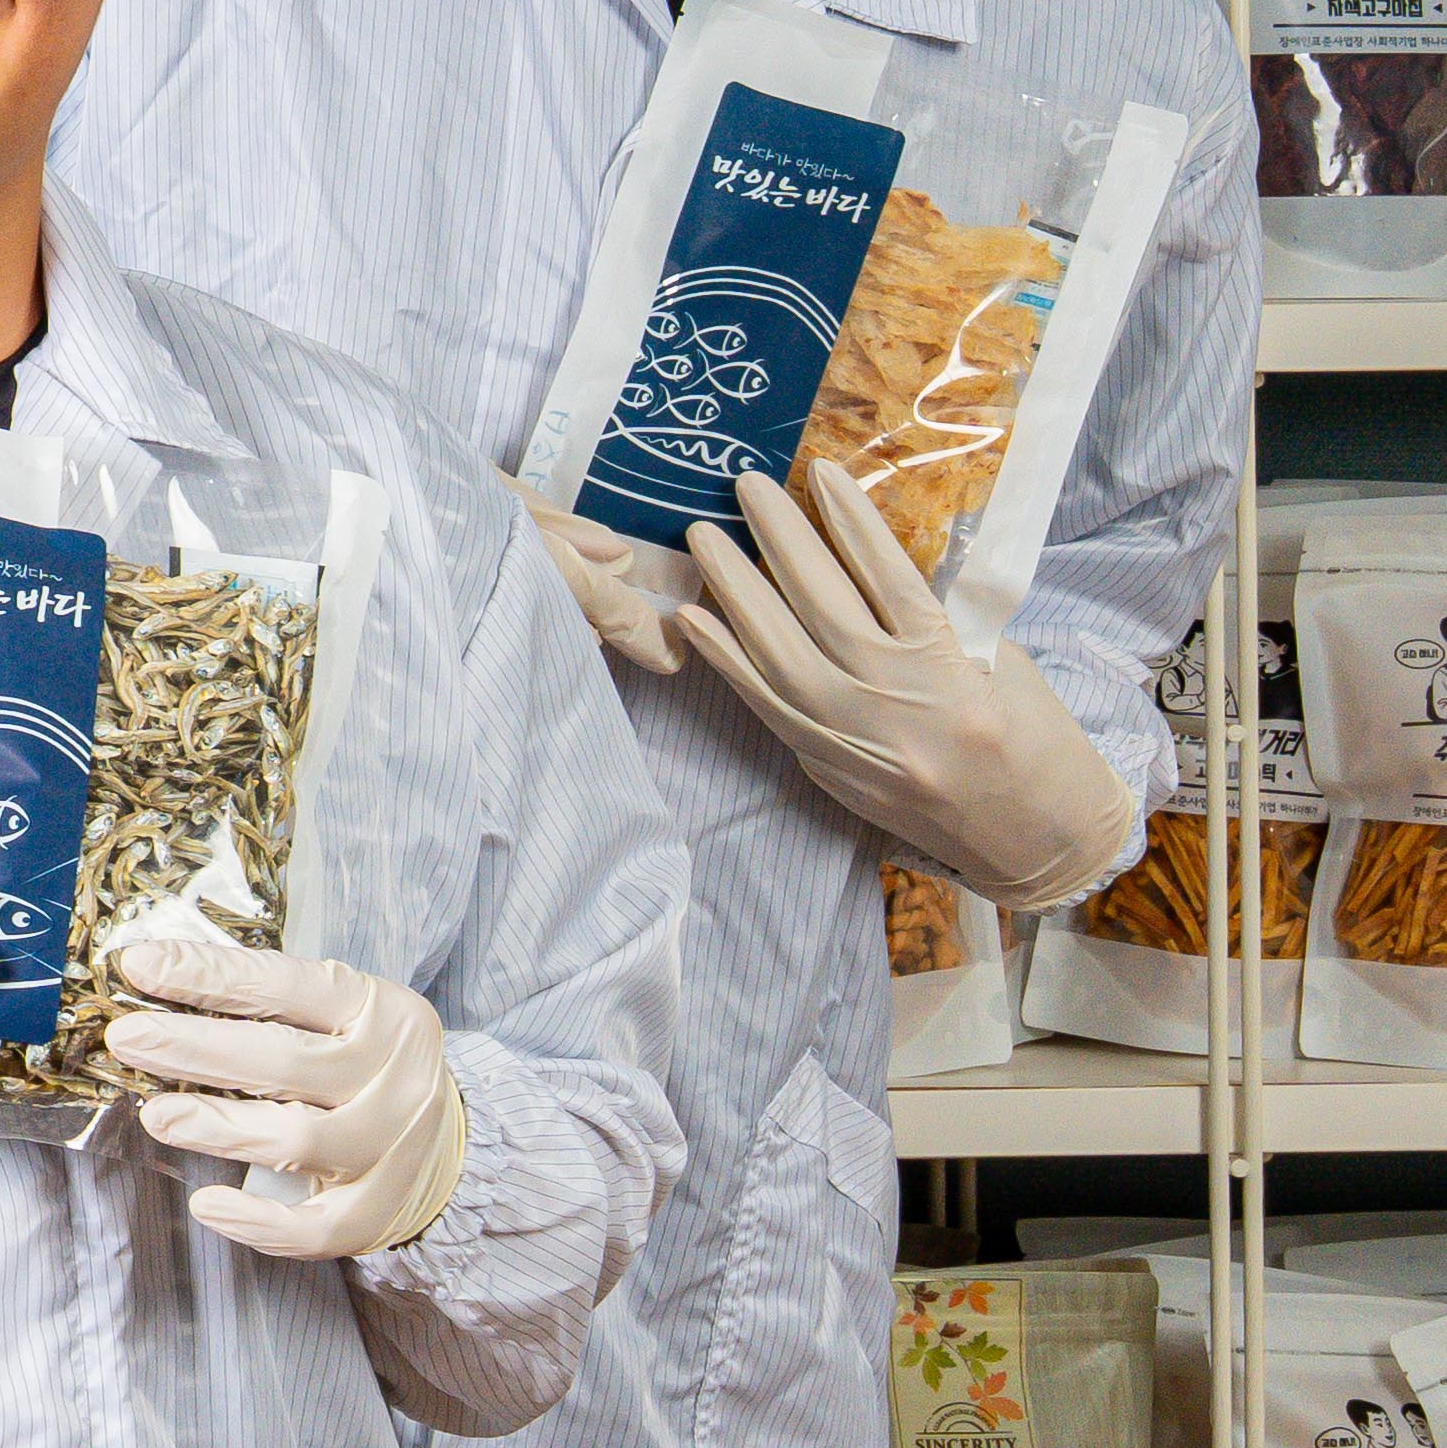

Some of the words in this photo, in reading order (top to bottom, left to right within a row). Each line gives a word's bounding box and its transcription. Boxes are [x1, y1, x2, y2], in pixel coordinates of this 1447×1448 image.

[1279, 35, 1363, 49] 장애인표준사업장
[1367, 36, 1417, 48] 사회적기업
[741, 142, 792, 166] 바다가
[713, 155, 802, 208] 맛있는
[806, 186, 871, 224] 바다
[16, 585, 92, 628] 바다
[1259, 728, 1306, 757] 거리
